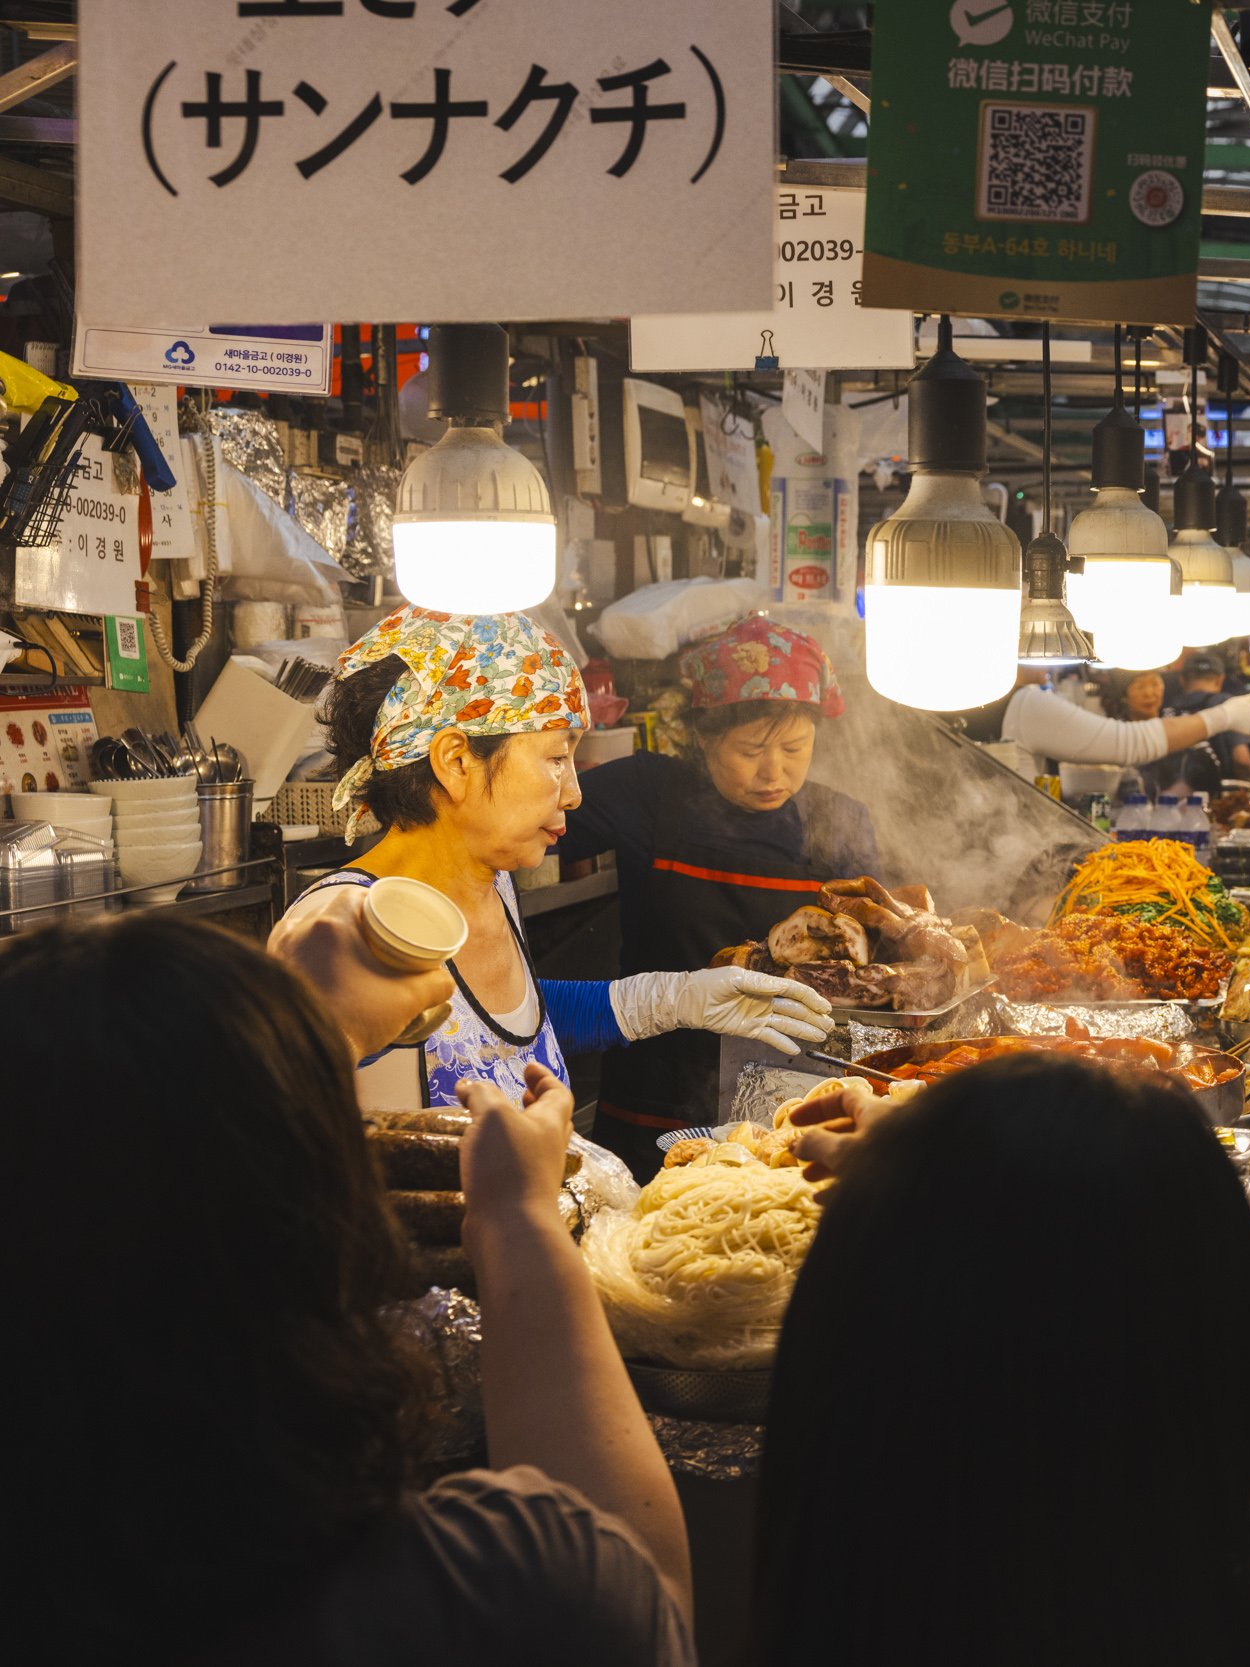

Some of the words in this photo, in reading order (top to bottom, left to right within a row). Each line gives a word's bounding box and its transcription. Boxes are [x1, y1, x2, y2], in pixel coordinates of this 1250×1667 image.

[1026, 0, 1133, 28] 微信支付
[1025, 30, 1093, 49] WeChat
[1099, 35, 1131, 54] Pay
[948, 58, 1133, 97] 微信扫码付款
[943, 232, 1050, 257] 동부A-64호
[224, 349, 267, 362] 새마을금고
[276, 354, 303, 364] 이경원
[214, 361, 312, 378] 0142-10-002039-0
